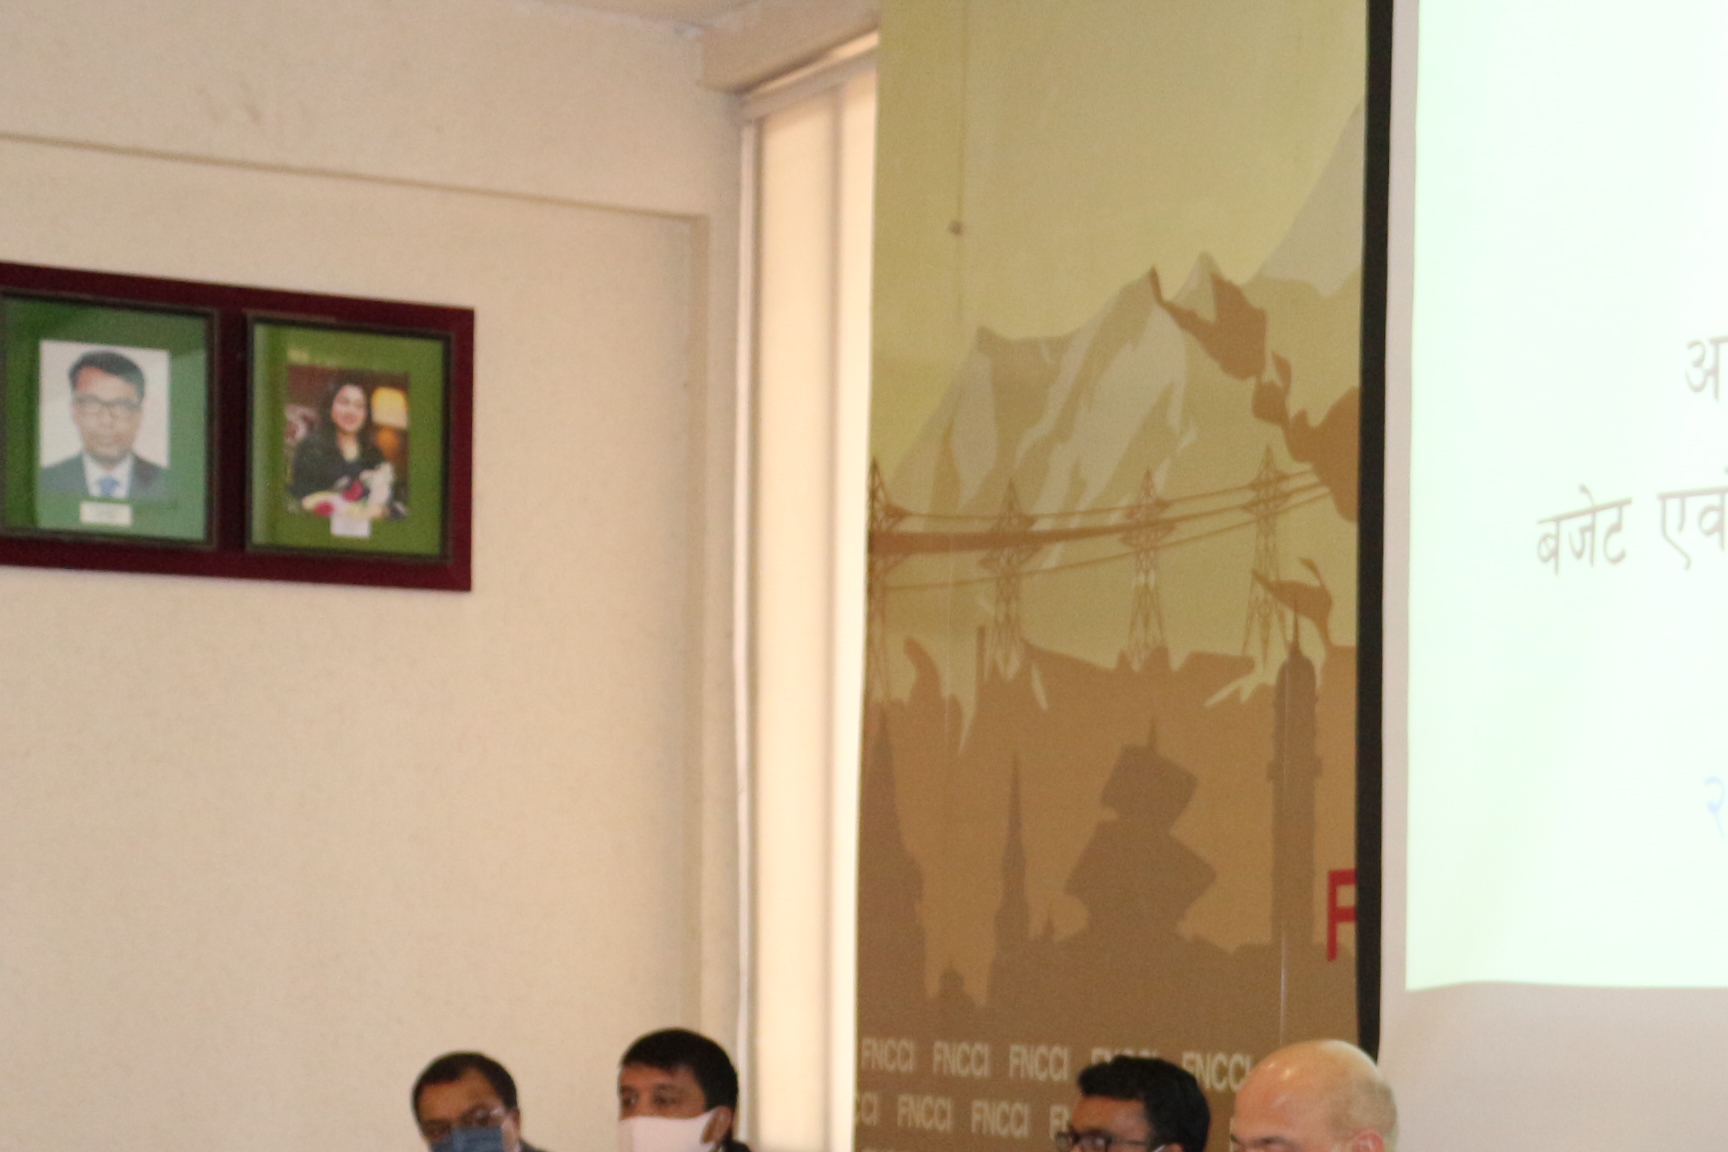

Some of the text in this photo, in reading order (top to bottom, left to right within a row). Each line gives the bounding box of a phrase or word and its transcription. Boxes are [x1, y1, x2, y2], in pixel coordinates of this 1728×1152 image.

[1537, 483, 1634, 576] बजेट
[861, 1038, 916, 1073] FNCCI
[932, 1040, 990, 1078] FNCCI
[1008, 1044, 1070, 1082] FNCCI
[897, 1094, 954, 1133] FNCCI
[971, 1099, 1029, 1138] FNCCI
